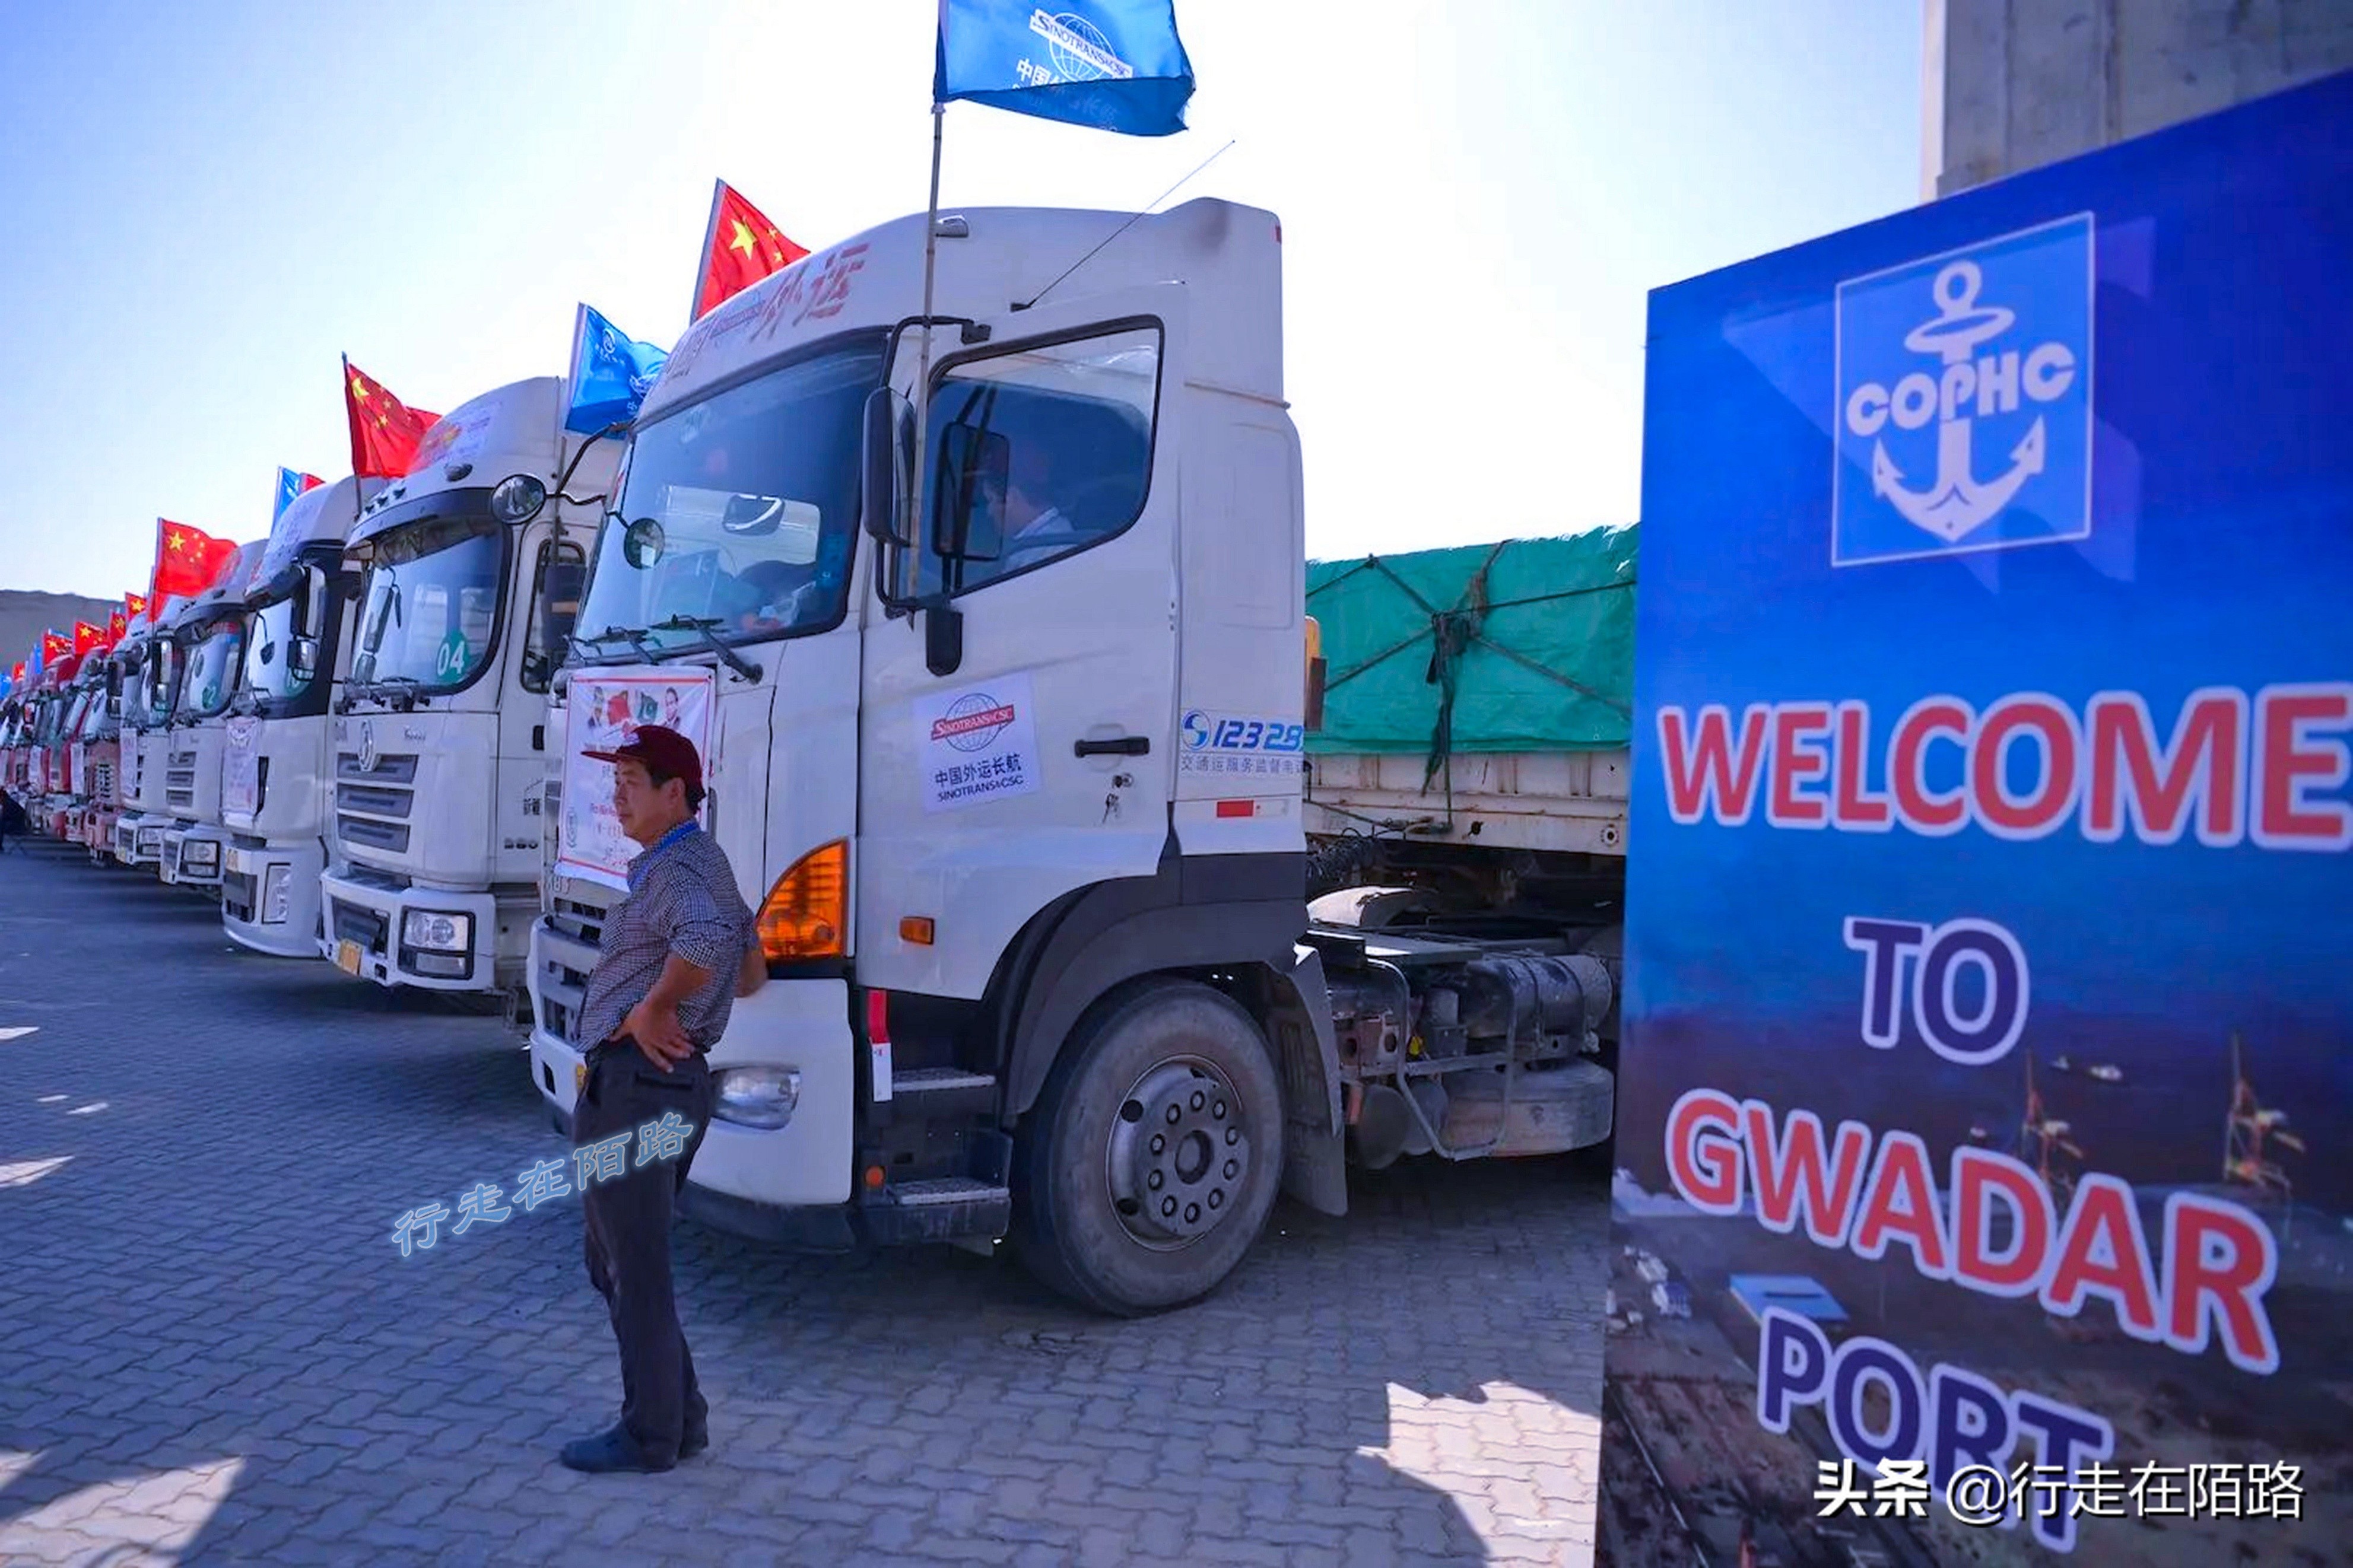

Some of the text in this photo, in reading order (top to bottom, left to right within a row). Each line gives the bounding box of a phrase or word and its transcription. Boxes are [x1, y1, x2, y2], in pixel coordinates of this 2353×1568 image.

[1846, 342, 2075, 437] COPHC
[437, 641, 465, 676] 04
[935, 753, 1021, 787] 中国外运长航
[1212, 720, 1303, 751] 12328
[1657, 681, 2353, 851] WELCOME
[1844, 917, 2029, 1065] TO
[1666, 1089, 2280, 1375] GWADAR
[1758, 1306, 2113, 1553] PORT
